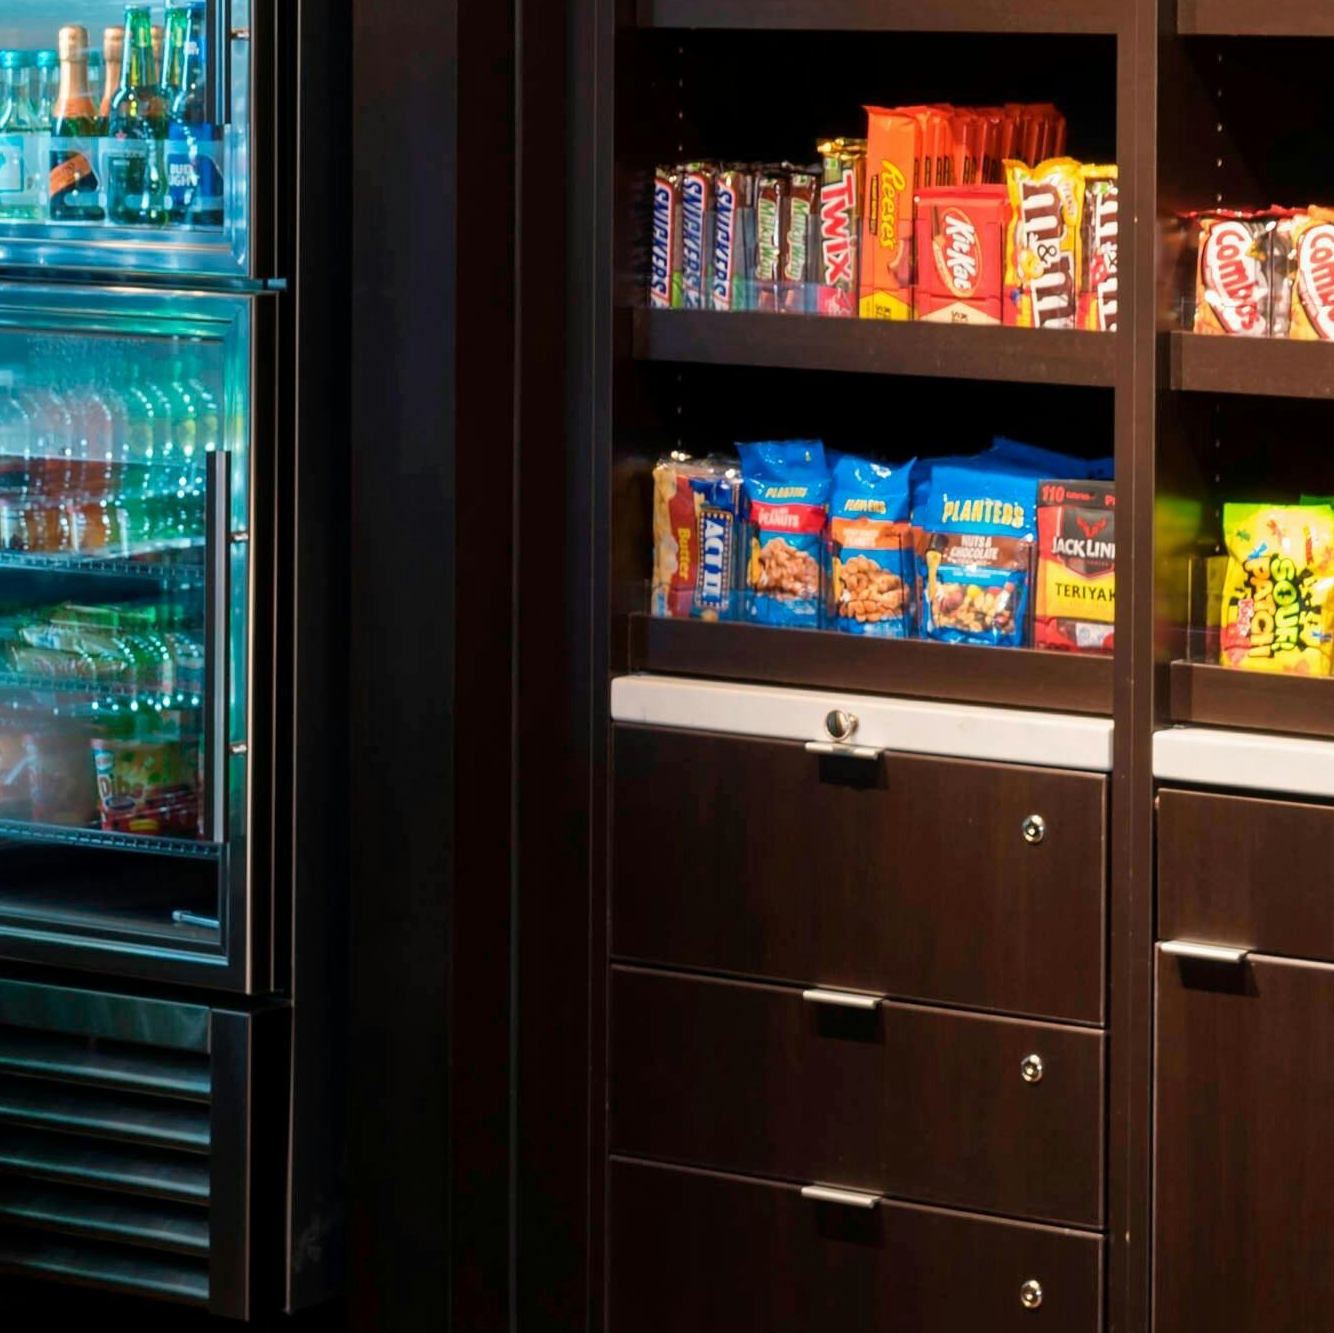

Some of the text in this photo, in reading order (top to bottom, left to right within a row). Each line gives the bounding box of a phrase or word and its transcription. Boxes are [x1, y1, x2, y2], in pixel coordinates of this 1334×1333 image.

[652, 187, 670, 295] SNICKERS
[683, 180, 703, 287] SNICKERS
[714, 189, 733, 298] SNICKERS
[821, 169, 855, 286] TWIX
[1215, 229, 1260, 331] Combos
[941, 498, 1025, 529] PLANTERS
[1042, 485, 1066, 503] 110
[677, 527, 691, 582] Butter
[704, 519, 724, 569] ACT
[1051, 537, 1116, 560] JACK LIN
[1056, 582, 1116, 602] TERIYAK
[1245, 555, 1276, 658] PATCH
[1271, 557, 1300, 651] SOUR
